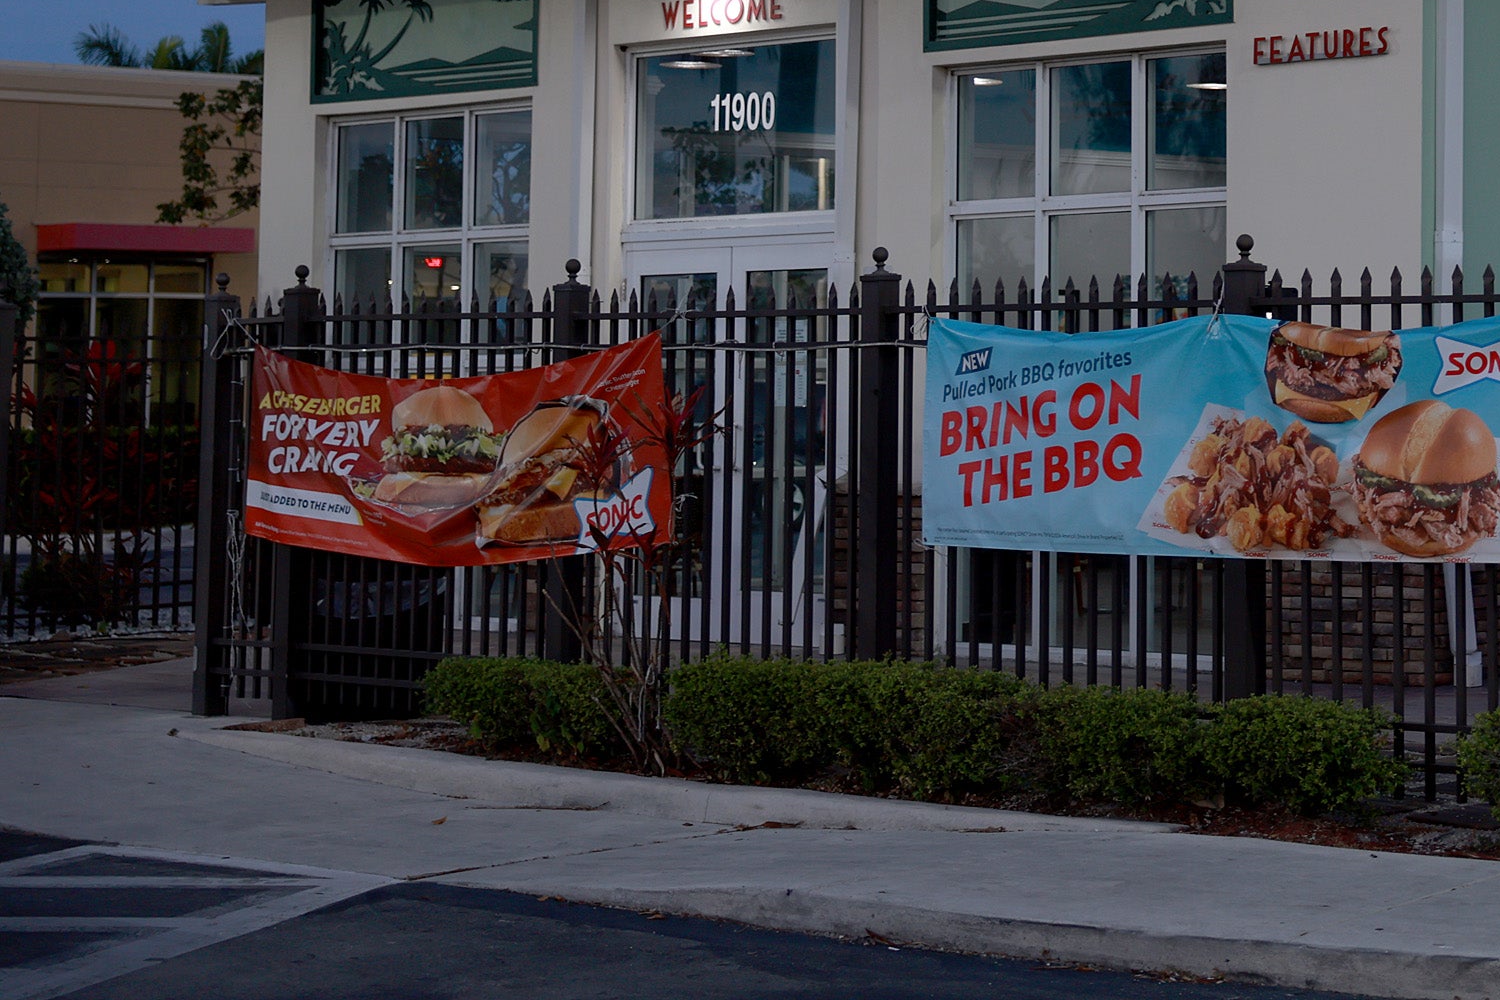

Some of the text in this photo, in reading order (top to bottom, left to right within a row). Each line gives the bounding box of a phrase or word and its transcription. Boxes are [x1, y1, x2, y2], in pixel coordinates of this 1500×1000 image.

[1253, 26, 1389, 65] FEATURES
[710, 91, 775, 132] 11900
[943, 351, 1132, 402] Pulled Pork BBQ favorites
[961, 350, 989, 372] NEW
[259, 392, 271, 409] A
[940, 373, 1142, 457] BRING ON
[306, 418, 380, 447] VERY
[958, 432, 1143, 508] THE BBQ
[298, 498, 309, 508] TO
[310, 500, 327, 512] THE
[327, 504, 352, 515] MENU
[585, 494, 643, 538] SONIC
